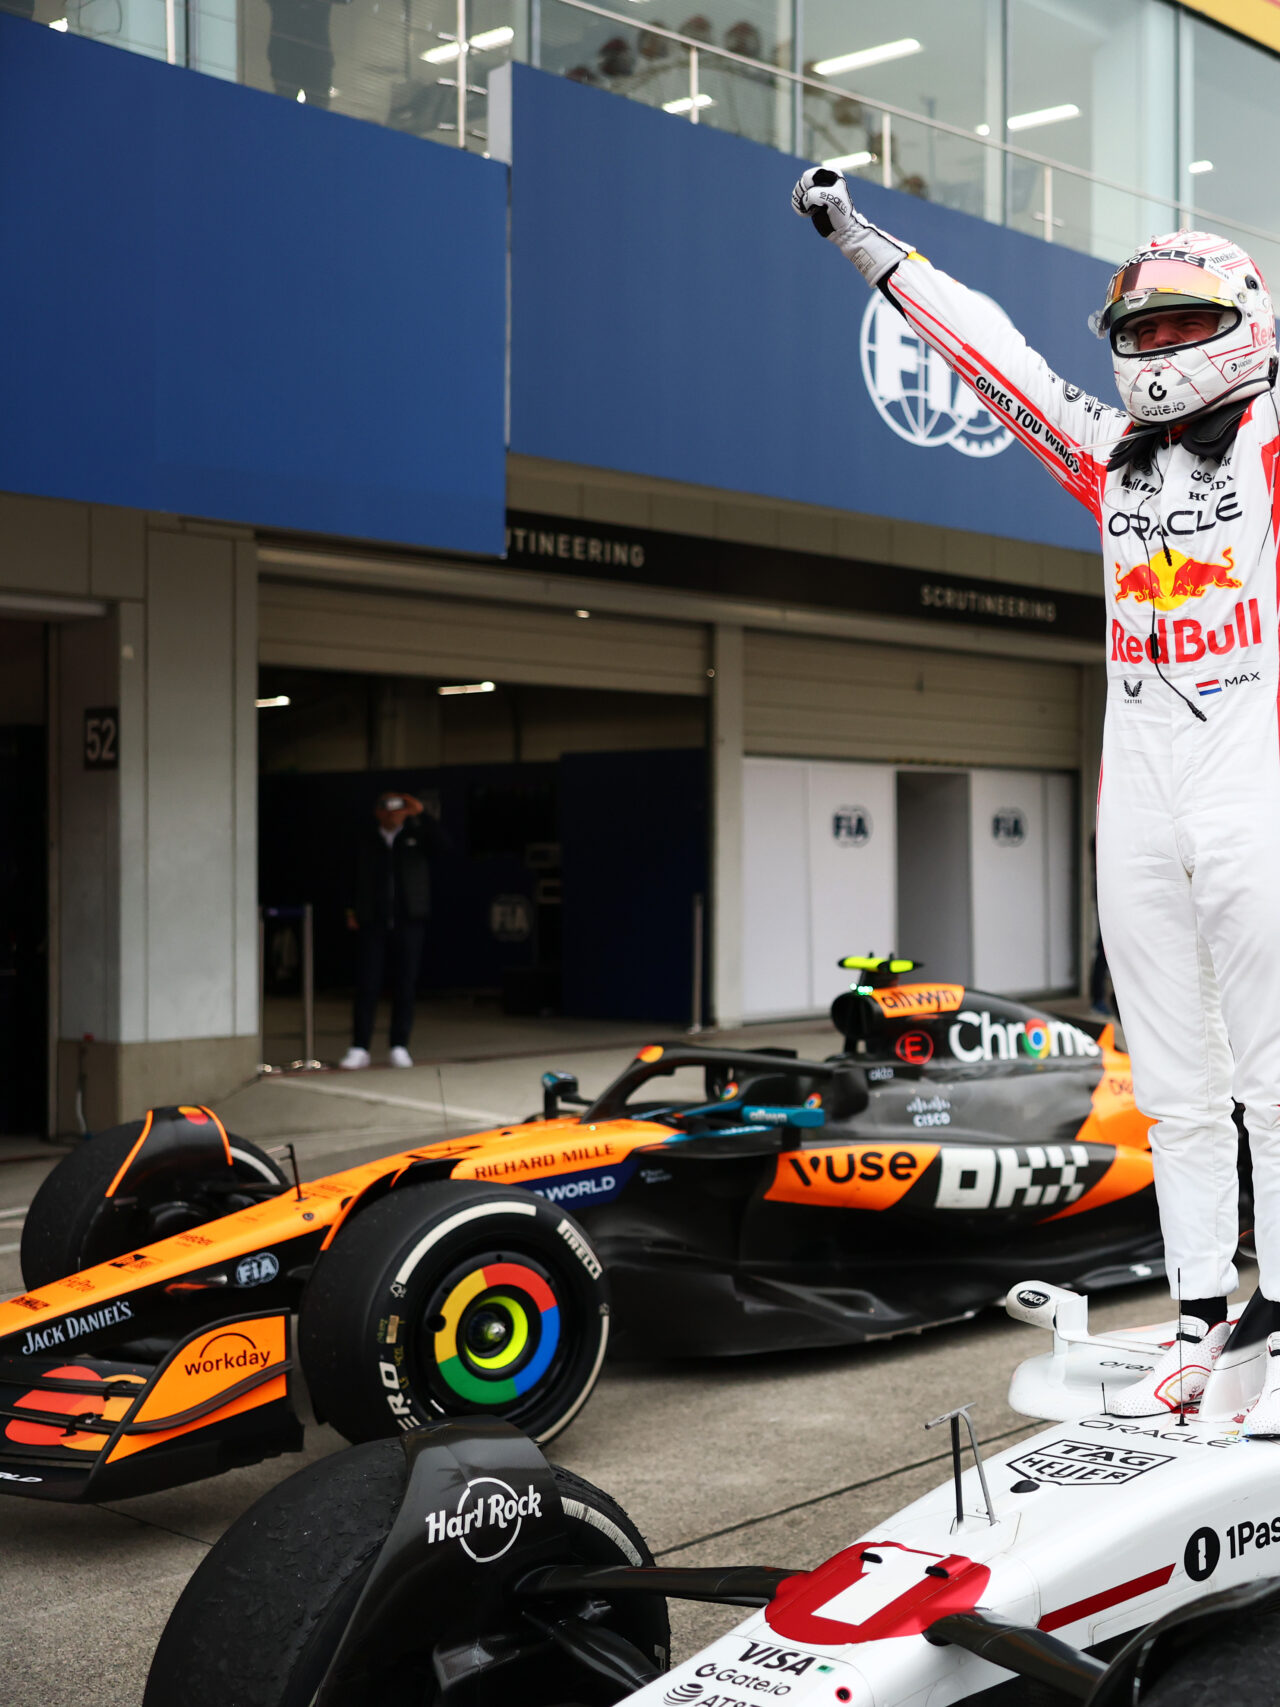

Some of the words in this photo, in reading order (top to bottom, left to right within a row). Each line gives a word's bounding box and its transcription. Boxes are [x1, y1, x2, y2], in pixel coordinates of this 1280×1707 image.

[975, 376, 1013, 412] GIVES
[1015, 406, 1042, 435] YOU
[1045, 430, 1080, 473] WINGS
[1141, 401, 1186, 417] Gate.io
[1108, 491, 1243, 541] ORACLE
[920, 584, 1056, 622] SCRUTINEERING
[1111, 618, 1170, 664] Red
[1172, 597, 1262, 664] Bull
[1224, 671, 1261, 688] MAX
[87, 718, 116, 760] 52
[880, 986, 957, 1011] allwyn
[948, 1011, 1101, 1063] Chrome
[474, 1154, 556, 1179] RICHARD
[562, 1143, 616, 1163] MILLE
[934, 1145, 1089, 1209] OKX
[545, 1175, 616, 1202] WORLD
[22, 1325, 65, 1356] JACK
[184, 1350, 271, 1377] workday
[1079, 1420, 1239, 1449] ORACLE
[1022, 1457, 1130, 1480] HEUER
[1061, 1444, 1155, 1466] TAG
[425, 1494, 484, 1544] Hard
[488, 1485, 543, 1529] Rock
[811, 1545, 949, 1626] 1
[738, 1641, 817, 1677] VISA
[715, 1668, 792, 1697] Gate.io
